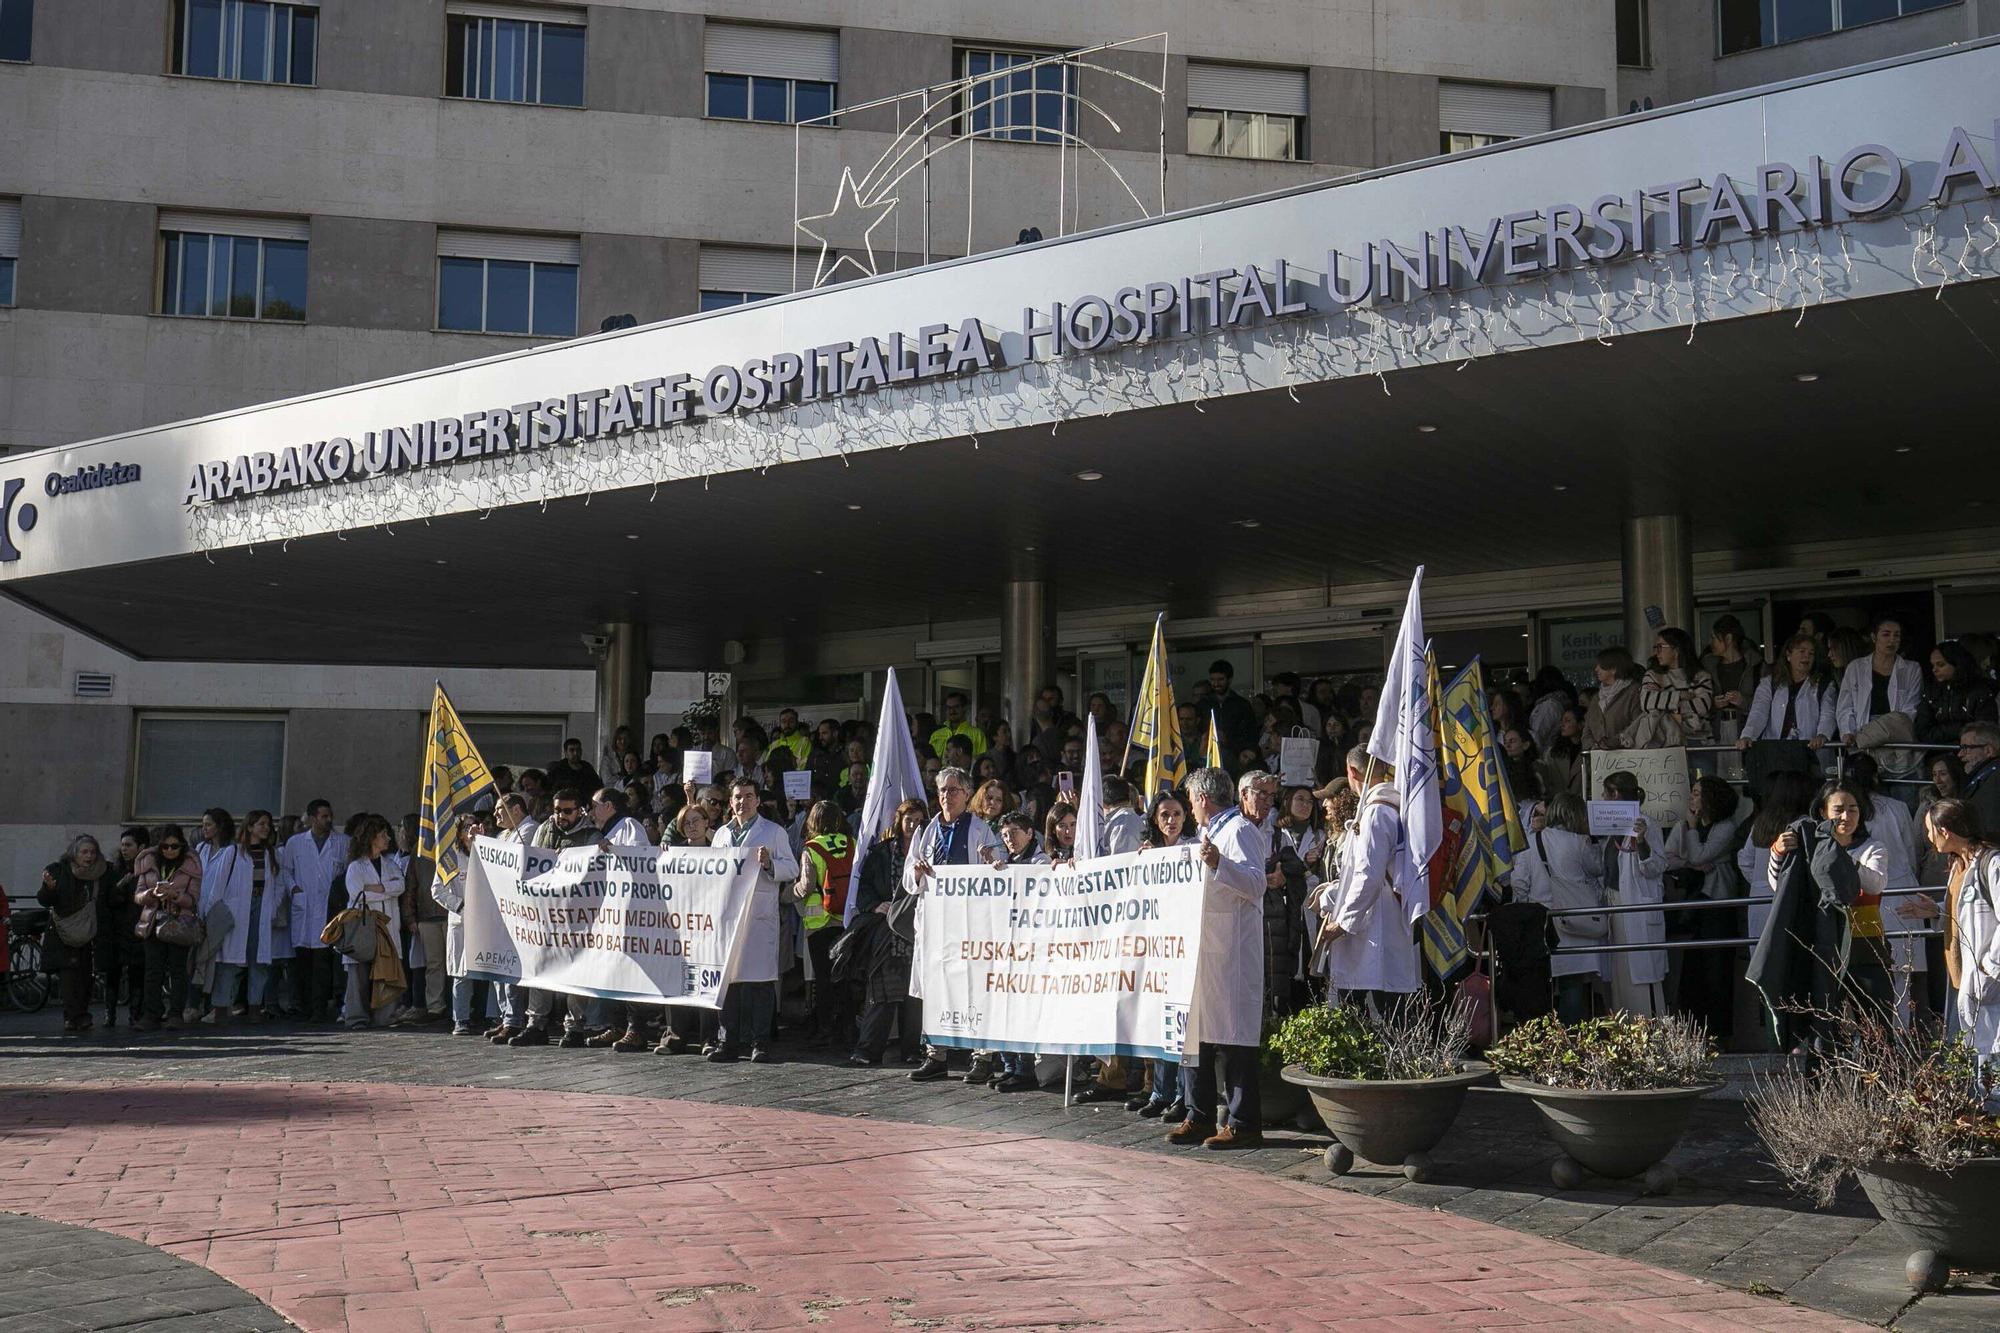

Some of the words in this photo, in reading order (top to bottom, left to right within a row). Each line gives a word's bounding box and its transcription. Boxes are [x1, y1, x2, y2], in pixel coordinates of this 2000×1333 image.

[186, 436, 354, 504] ARABAKO
[363, 372, 693, 475] UNIBERTSITATE
[703, 317, 991, 414] OSPITALEA
[1023, 258, 1308, 361] HOSPITAL
[1327, 143, 1903, 305] UNIVERSITARIO
[45, 462, 142, 497] Osakidetza
[661, 851, 728, 876] MÉDICO
[733, 857, 746, 876] Y
[621, 881, 673, 901] PROPIO
[935, 876, 1018, 901] EUSKADI,
[548, 907, 620, 926] ESTATUTU
[625, 909, 682, 930] MEDIKO
[686, 912, 714, 931] ETA
[1009, 903, 1113, 929] FACULTATIVO
[515, 925, 604, 950] FAKULTATIBO
[606, 934, 649, 955] BATEN
[653, 937, 691, 957] ALDE
